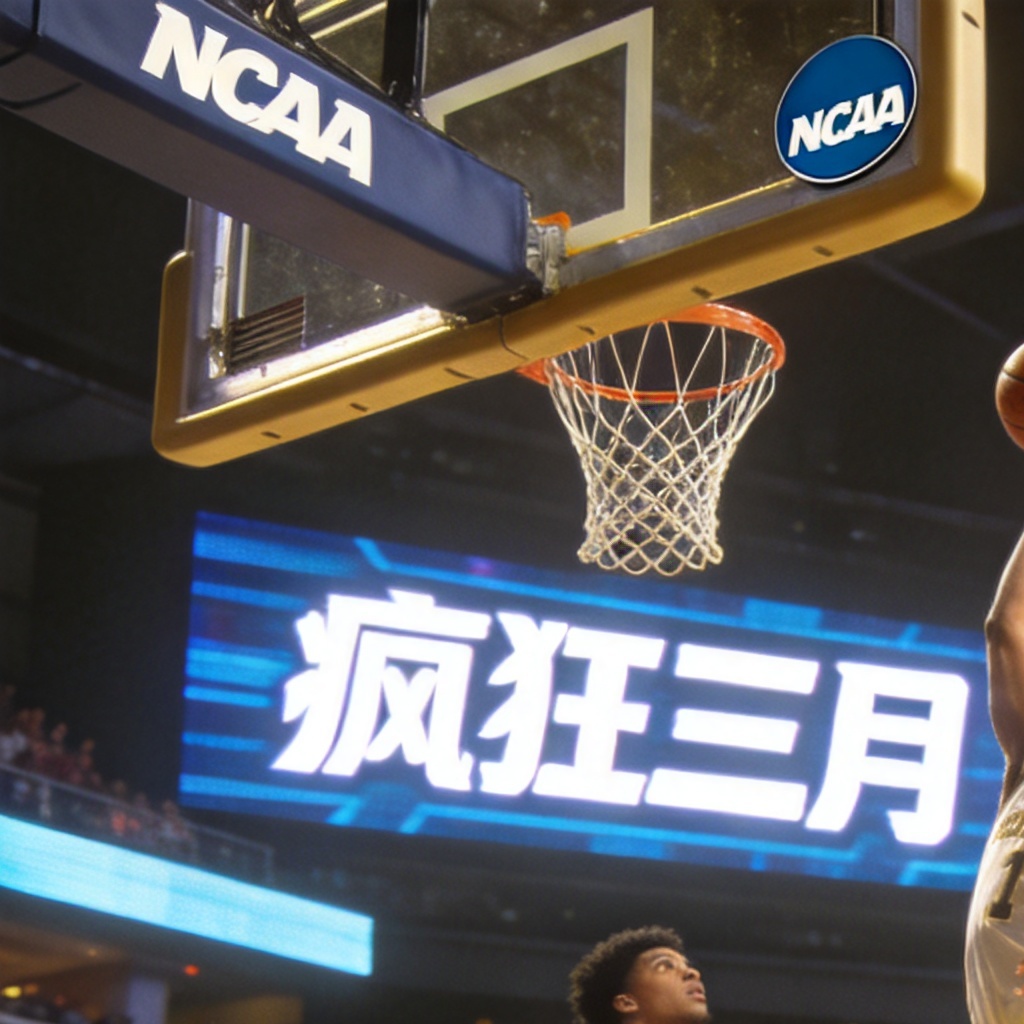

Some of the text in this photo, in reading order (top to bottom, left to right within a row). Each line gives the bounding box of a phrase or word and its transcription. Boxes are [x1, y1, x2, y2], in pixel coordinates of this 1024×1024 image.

[140, 1, 372, 187] NCAA
[788, 84, 905, 158] NCAA
[270, 588, 971, 848] 疯狂三月
